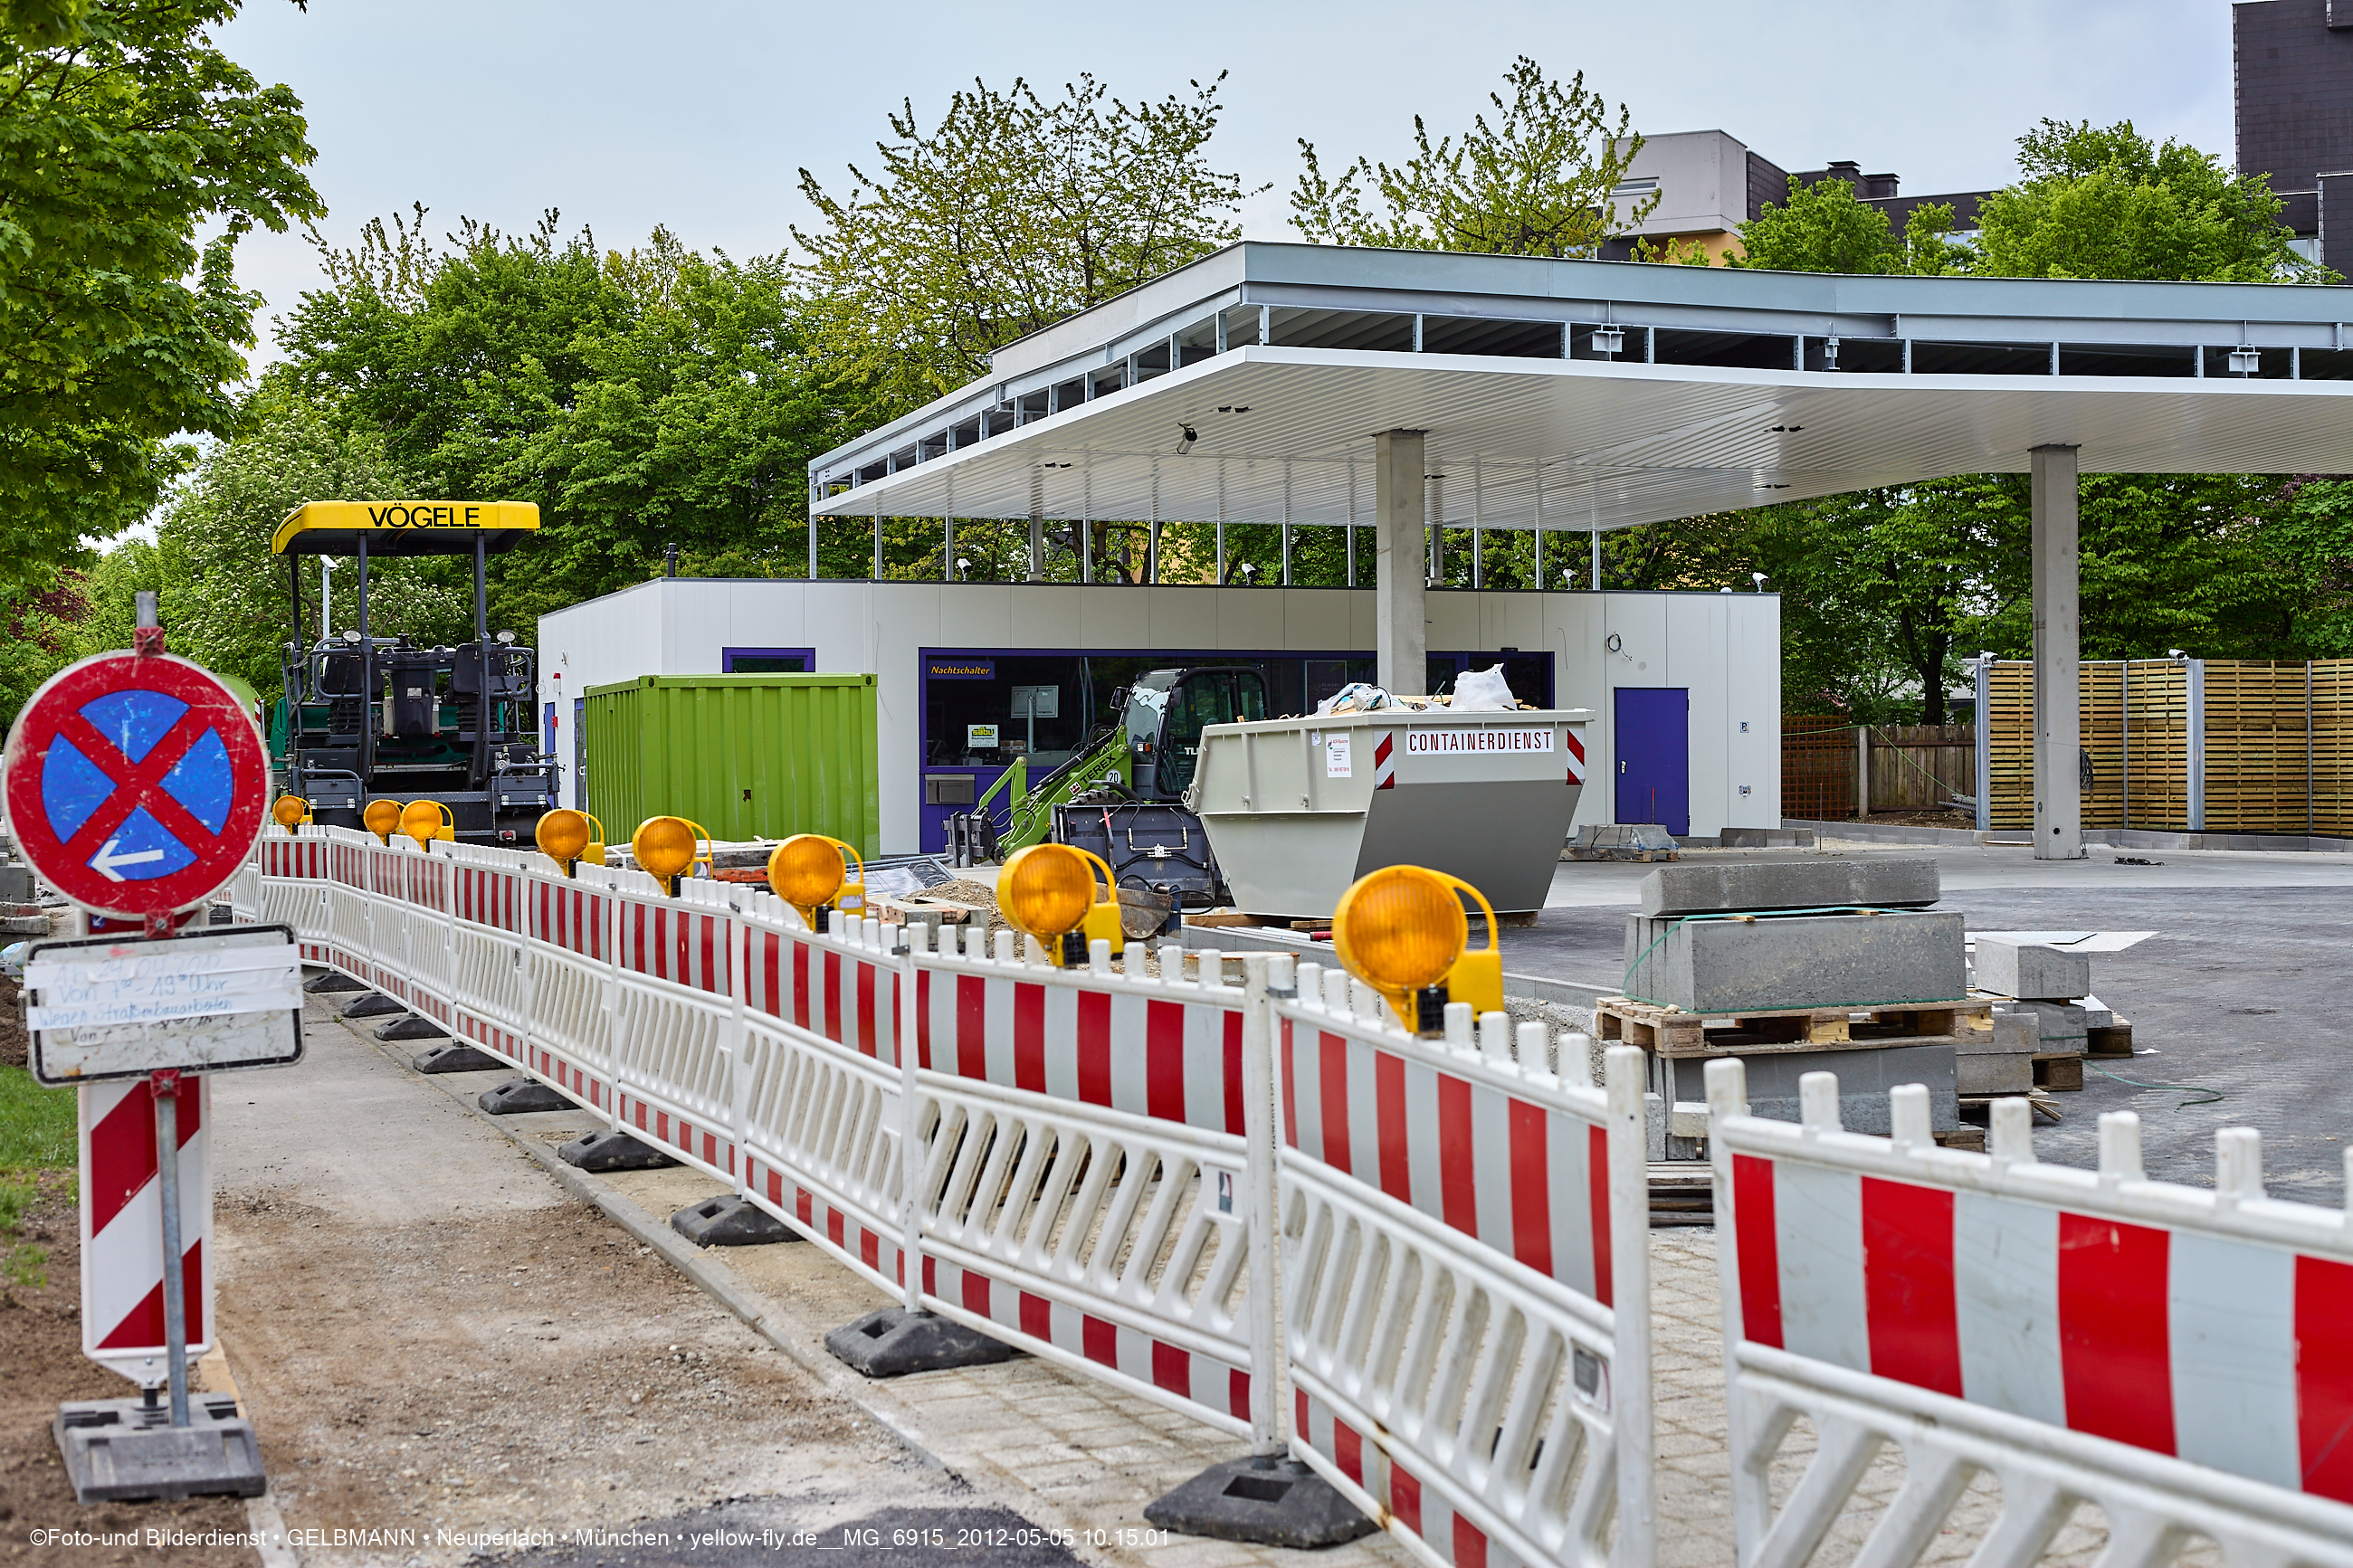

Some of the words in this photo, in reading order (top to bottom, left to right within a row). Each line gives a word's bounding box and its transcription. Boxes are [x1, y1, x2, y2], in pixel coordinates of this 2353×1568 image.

[367, 502, 481, 528] VÖGELE
[930, 665, 991, 675] Nachtschalter
[1409, 731, 1551, 752] CONTAINERDIENST
[1080, 753, 1116, 784] TEREX
[1109, 772, 1119, 784] 20
